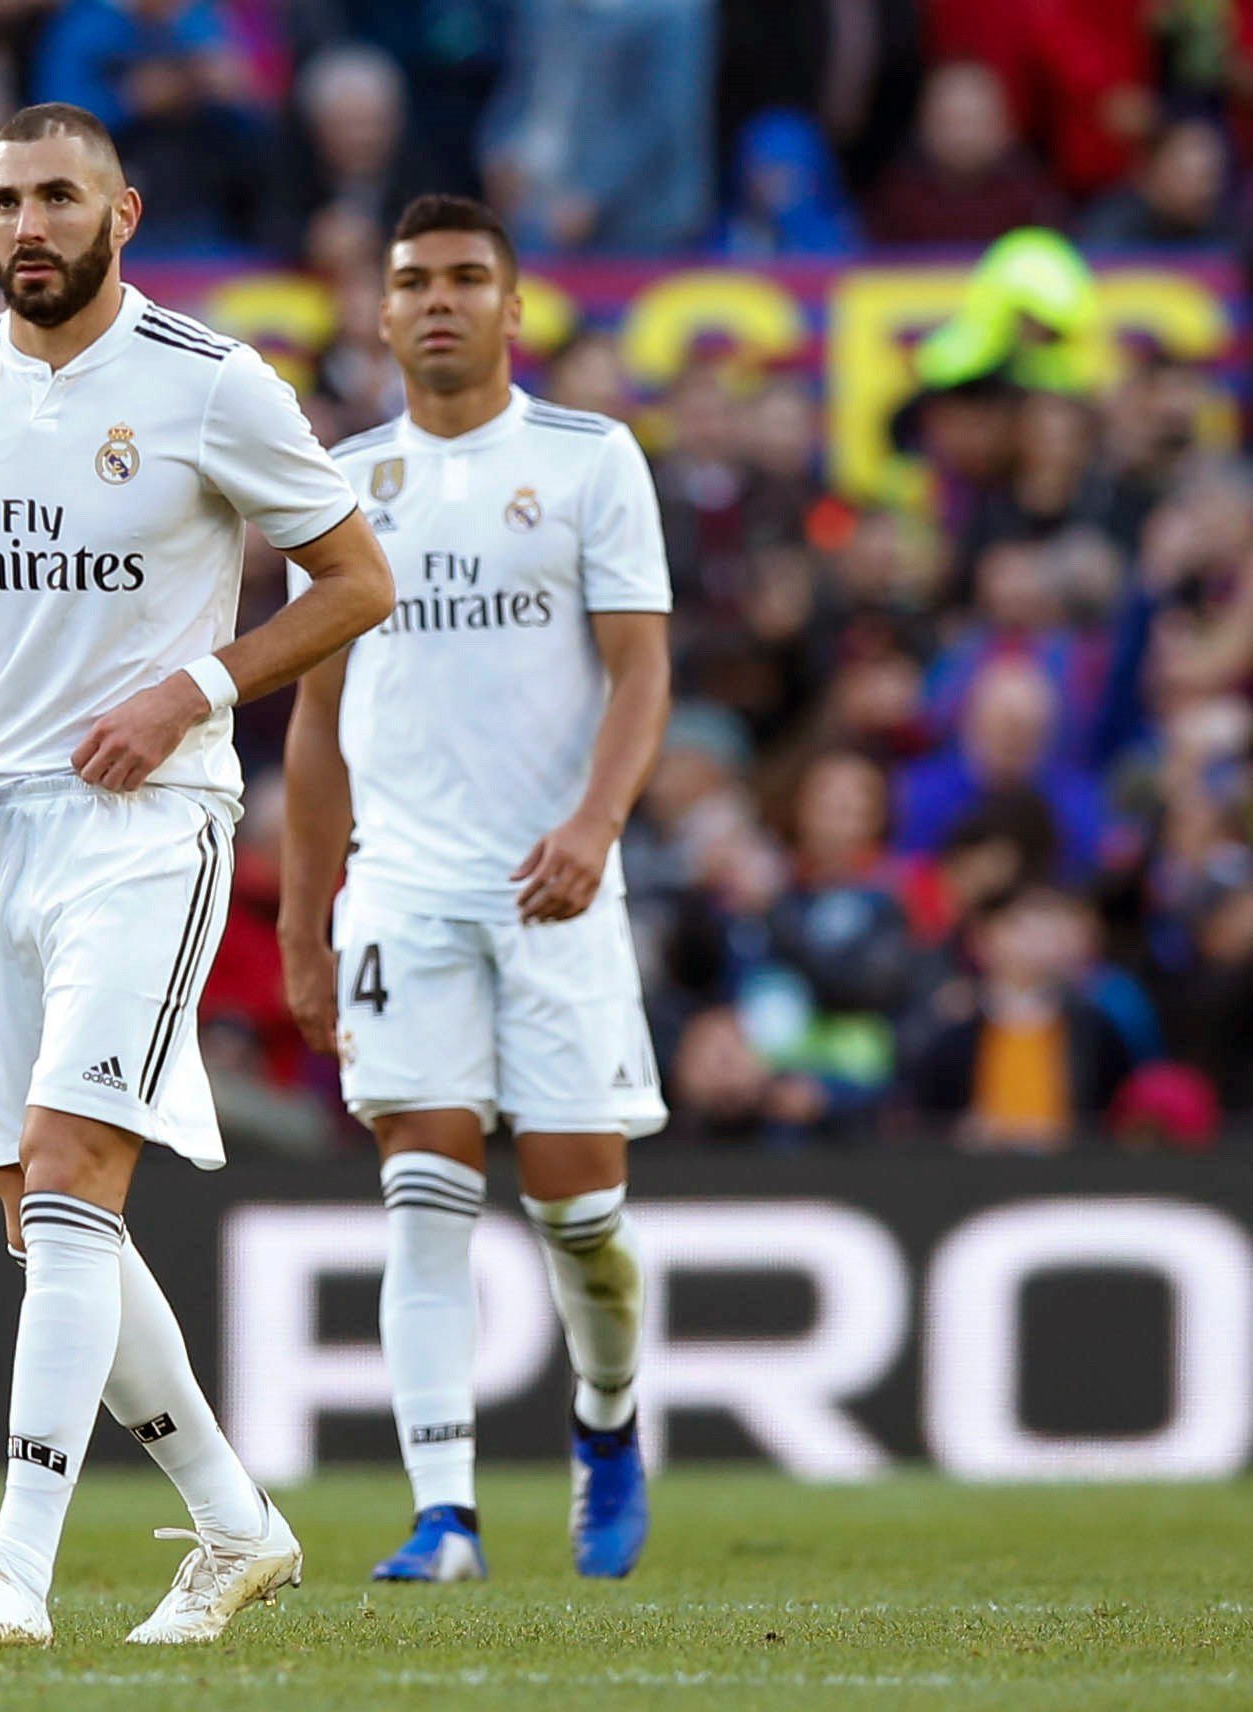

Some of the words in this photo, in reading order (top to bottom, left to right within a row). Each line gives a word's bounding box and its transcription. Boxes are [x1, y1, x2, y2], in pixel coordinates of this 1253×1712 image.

[2, 499, 64, 541] Fly
[424, 552, 481, 586] Fly
[380, 587, 553, 636] mirates
[352, 943, 388, 1014] 4
[82, 1071, 128, 1092] adidas
[220, 1200, 1253, 1486] PRO
